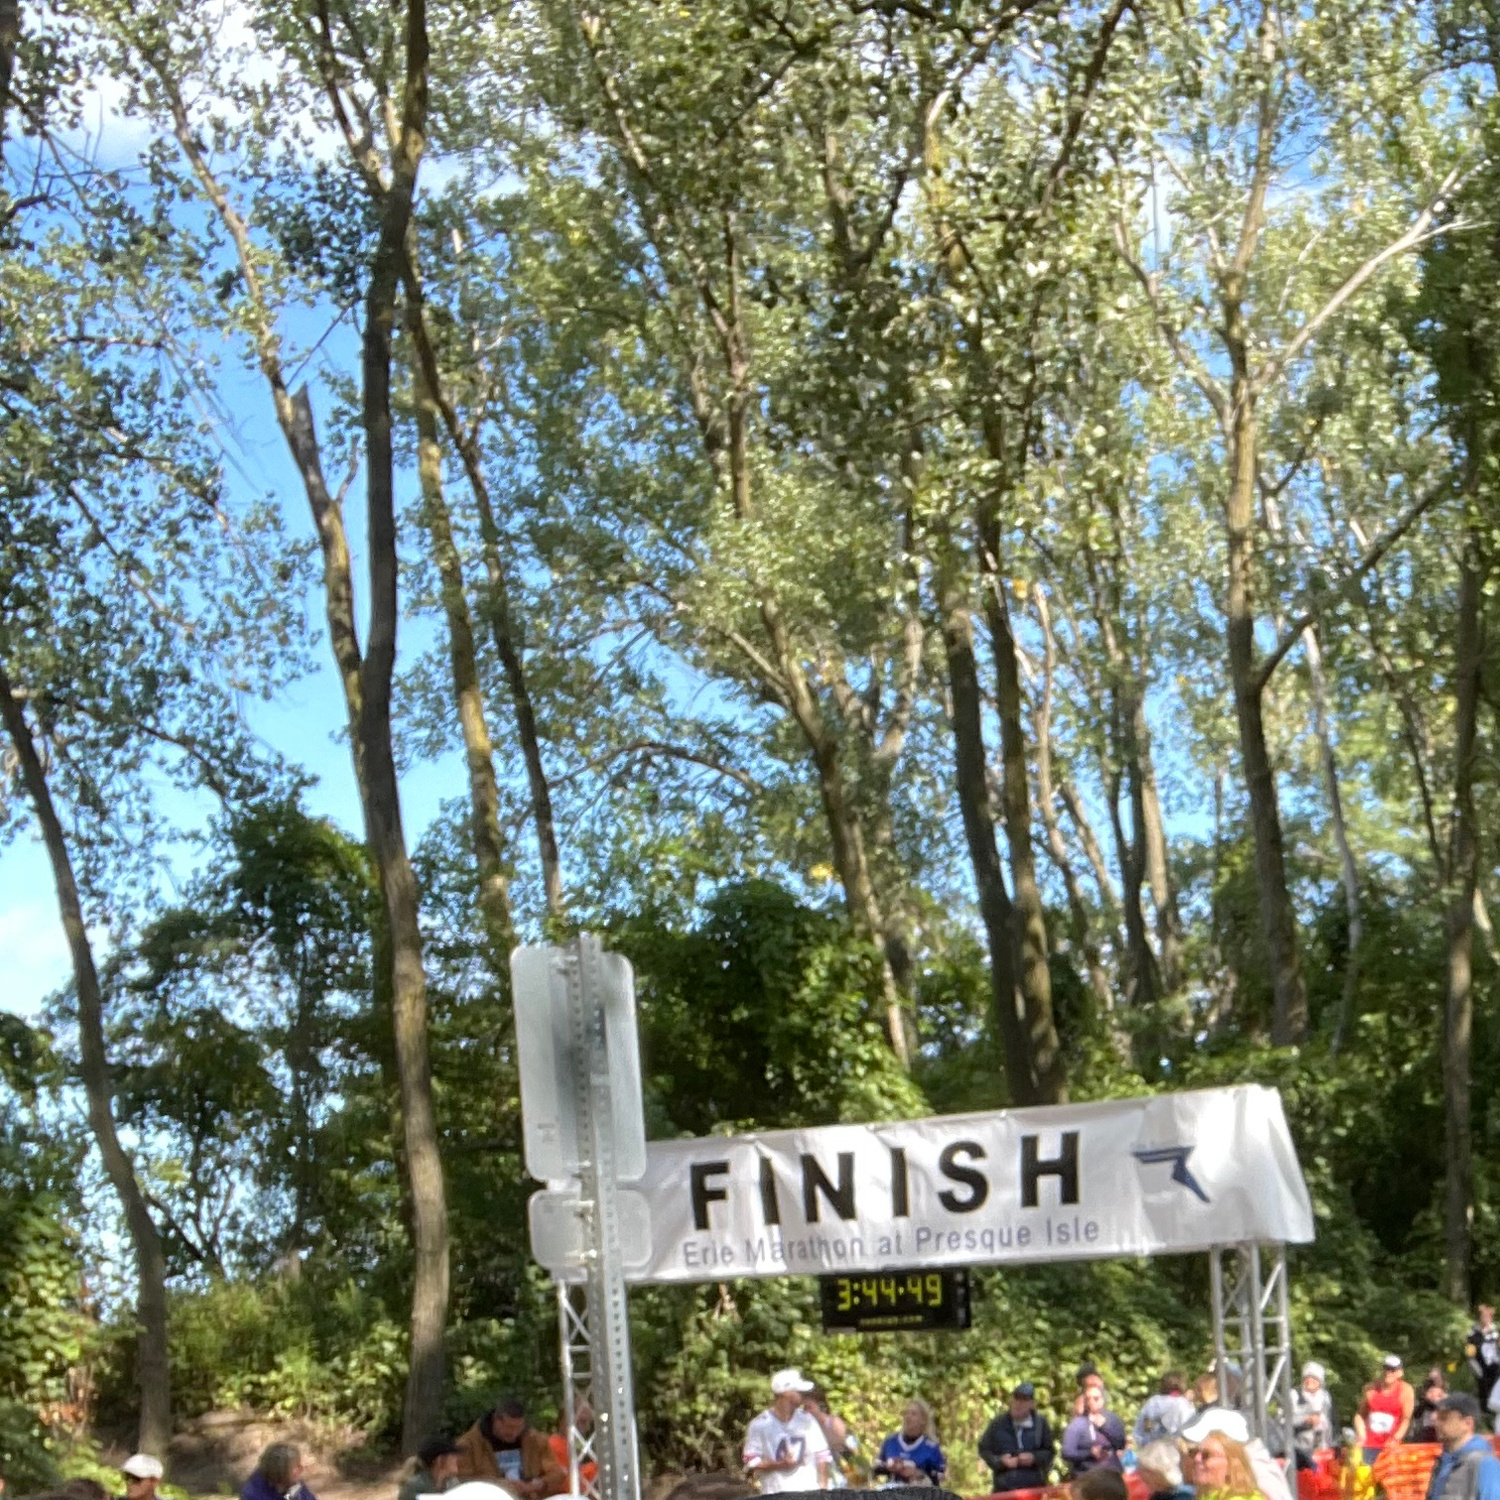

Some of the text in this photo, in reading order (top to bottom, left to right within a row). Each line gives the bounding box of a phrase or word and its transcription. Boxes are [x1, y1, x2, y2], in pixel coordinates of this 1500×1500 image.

[690, 1131, 1080, 1230] FINISH
[684, 1216, 1099, 1267] Erie Marathon at Presque Isle
